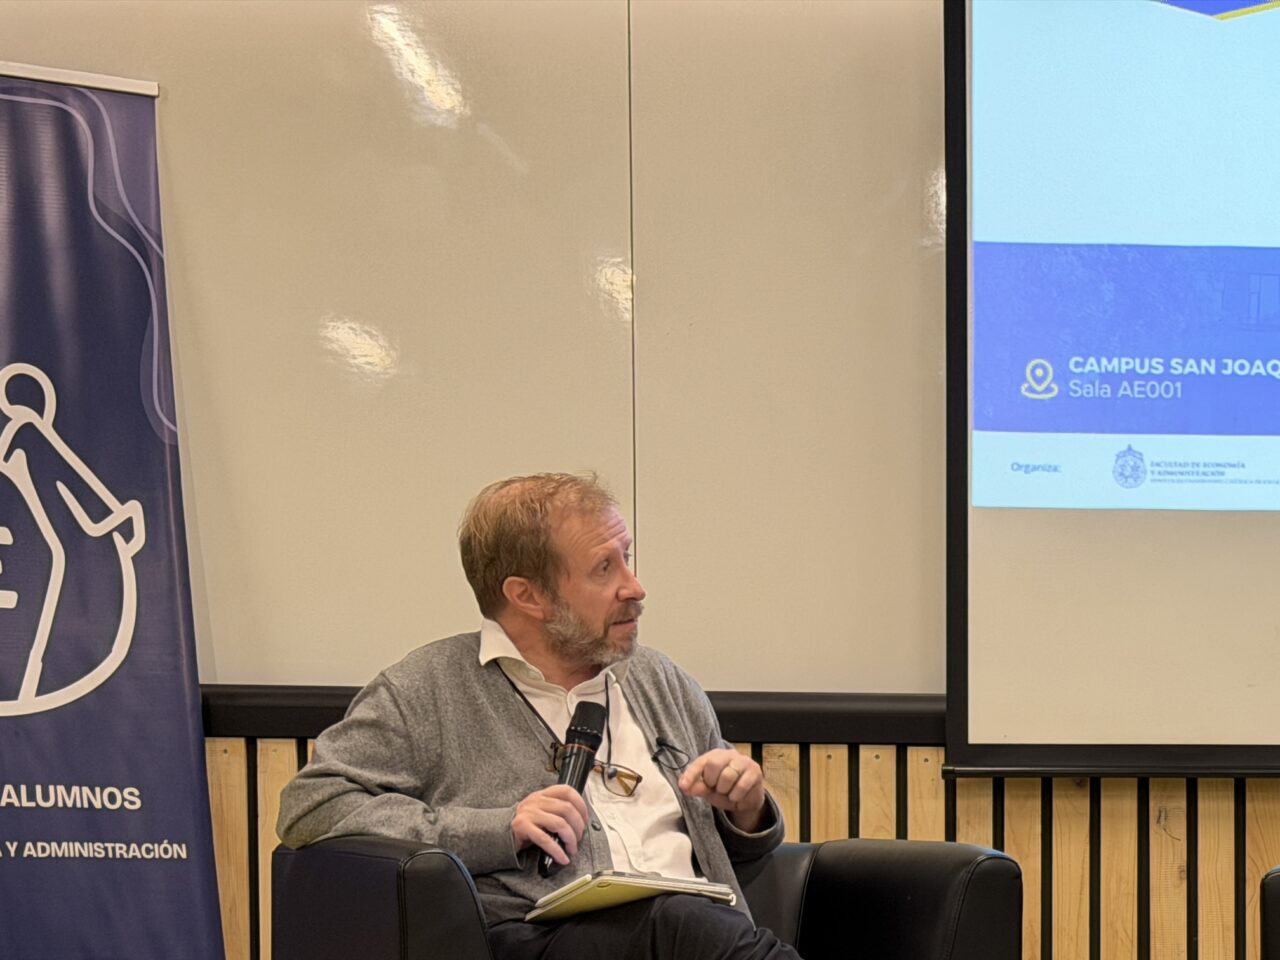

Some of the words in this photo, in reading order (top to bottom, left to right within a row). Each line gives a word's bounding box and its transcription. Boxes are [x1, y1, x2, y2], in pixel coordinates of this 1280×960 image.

[1068, 356, 1165, 376] CAMPUS
[1169, 357, 1217, 376] SAN
[1068, 379, 1112, 398] Sala
[1117, 380, 1183, 399] AE001
[0, 784, 143, 810] ALUMNOS
[5, 841, 18, 858] Y
[23, 839, 188, 859] ADMINISTRACIÓN
